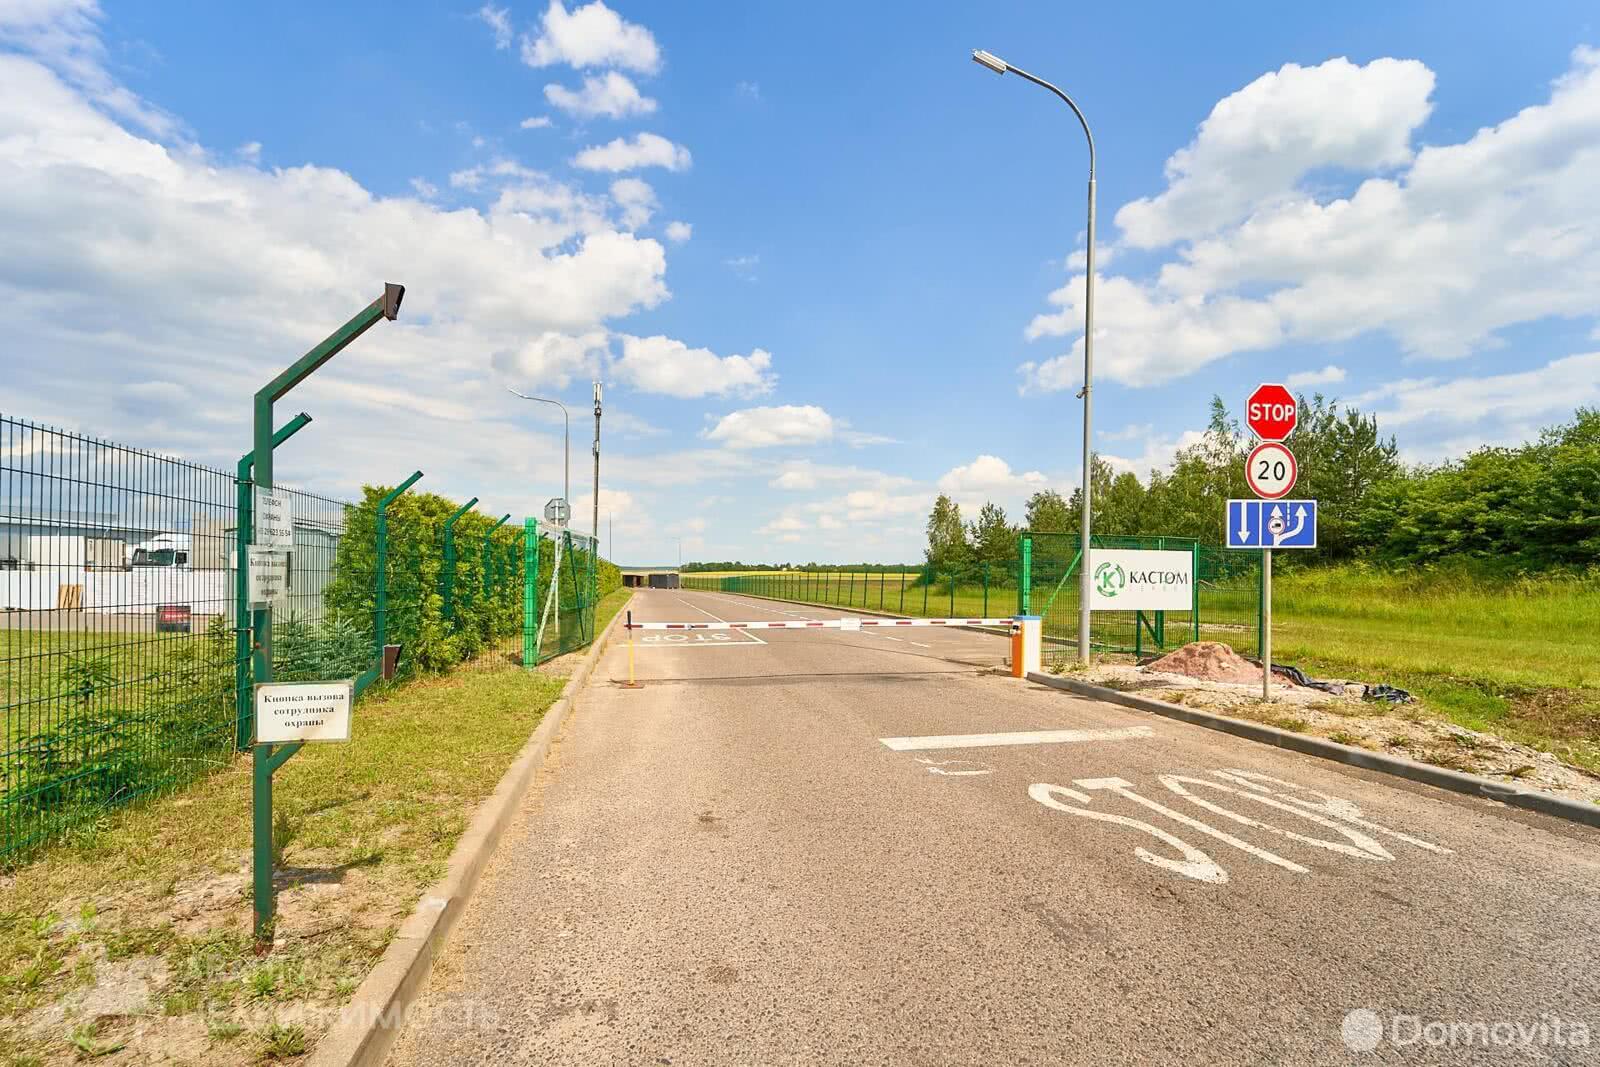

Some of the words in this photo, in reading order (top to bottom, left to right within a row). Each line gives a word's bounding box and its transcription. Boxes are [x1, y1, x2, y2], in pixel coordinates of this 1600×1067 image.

[1250, 403, 1295, 422] STOP
[1257, 460, 1286, 481] 20
[641, 632, 732, 642] STOP
[263, 695, 305, 704] Кнопка
[306, 693, 345, 702] вызова
[273, 706, 335, 717] сотрудника
[284, 719, 325, 728] охраны
